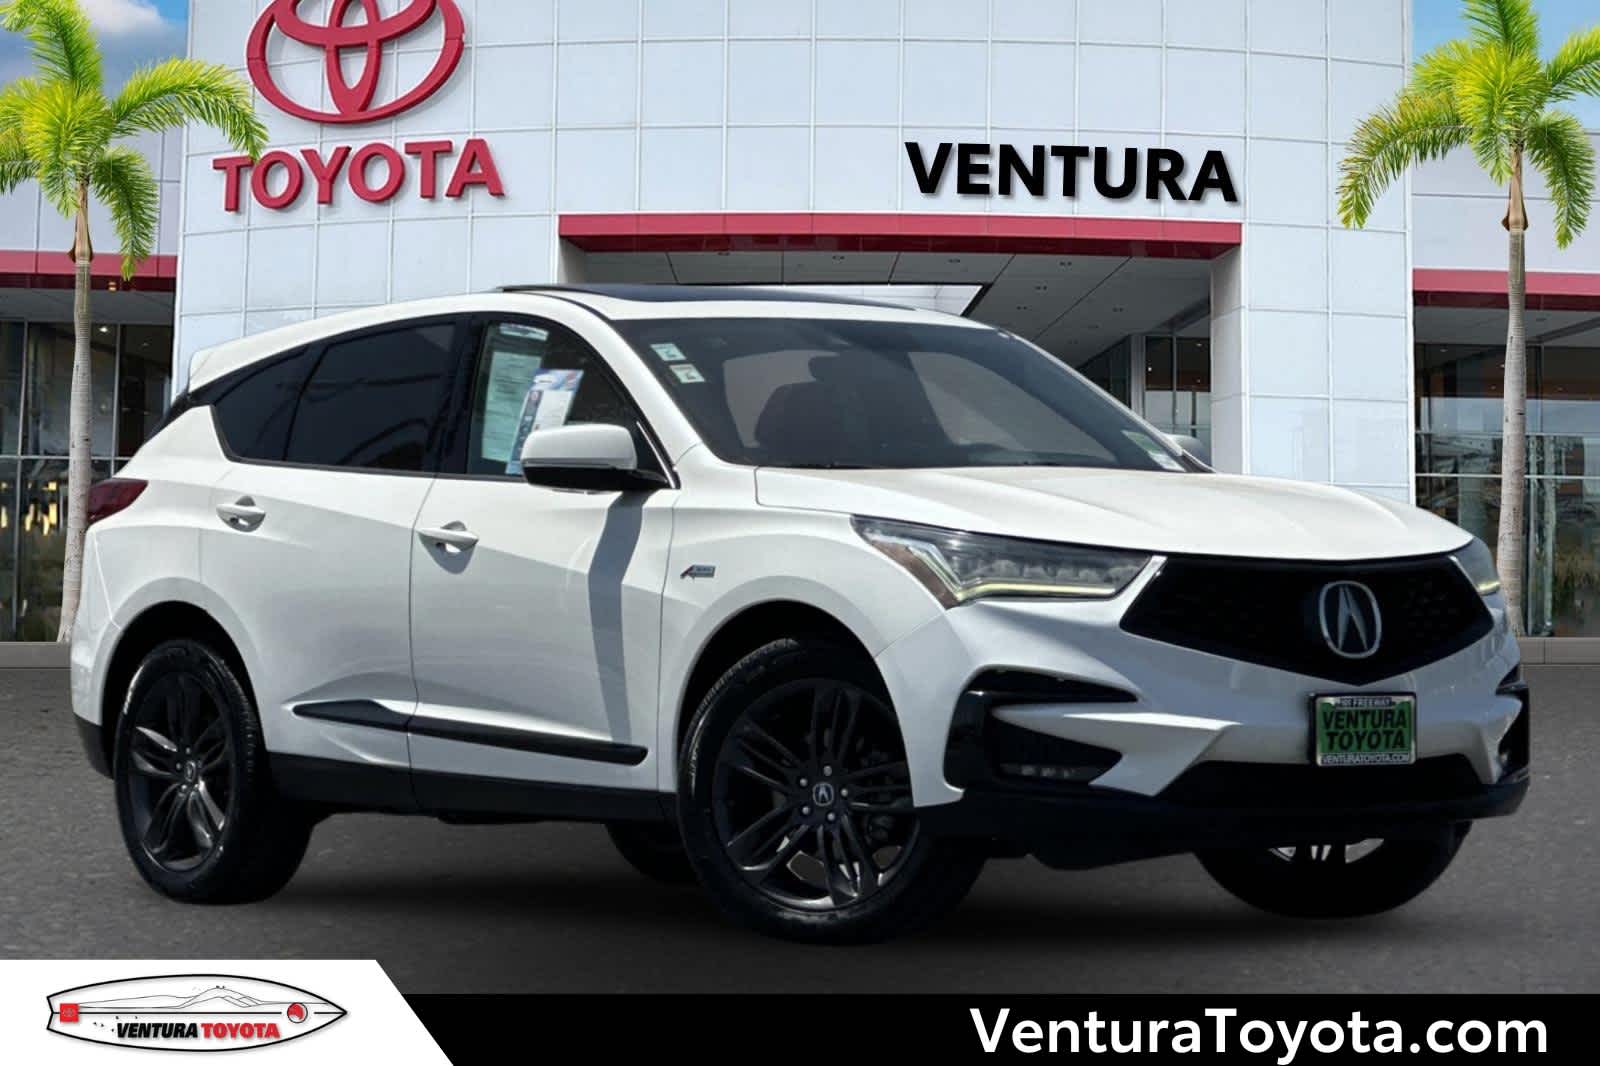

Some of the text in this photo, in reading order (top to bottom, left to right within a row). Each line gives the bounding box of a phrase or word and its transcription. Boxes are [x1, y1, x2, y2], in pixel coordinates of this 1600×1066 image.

[212, 138, 505, 213] TOYOTA
[905, 141, 1238, 203] VENTURA
[1322, 709, 1407, 729] VENTURA
[1326, 730, 1405, 751] TOYOTA
